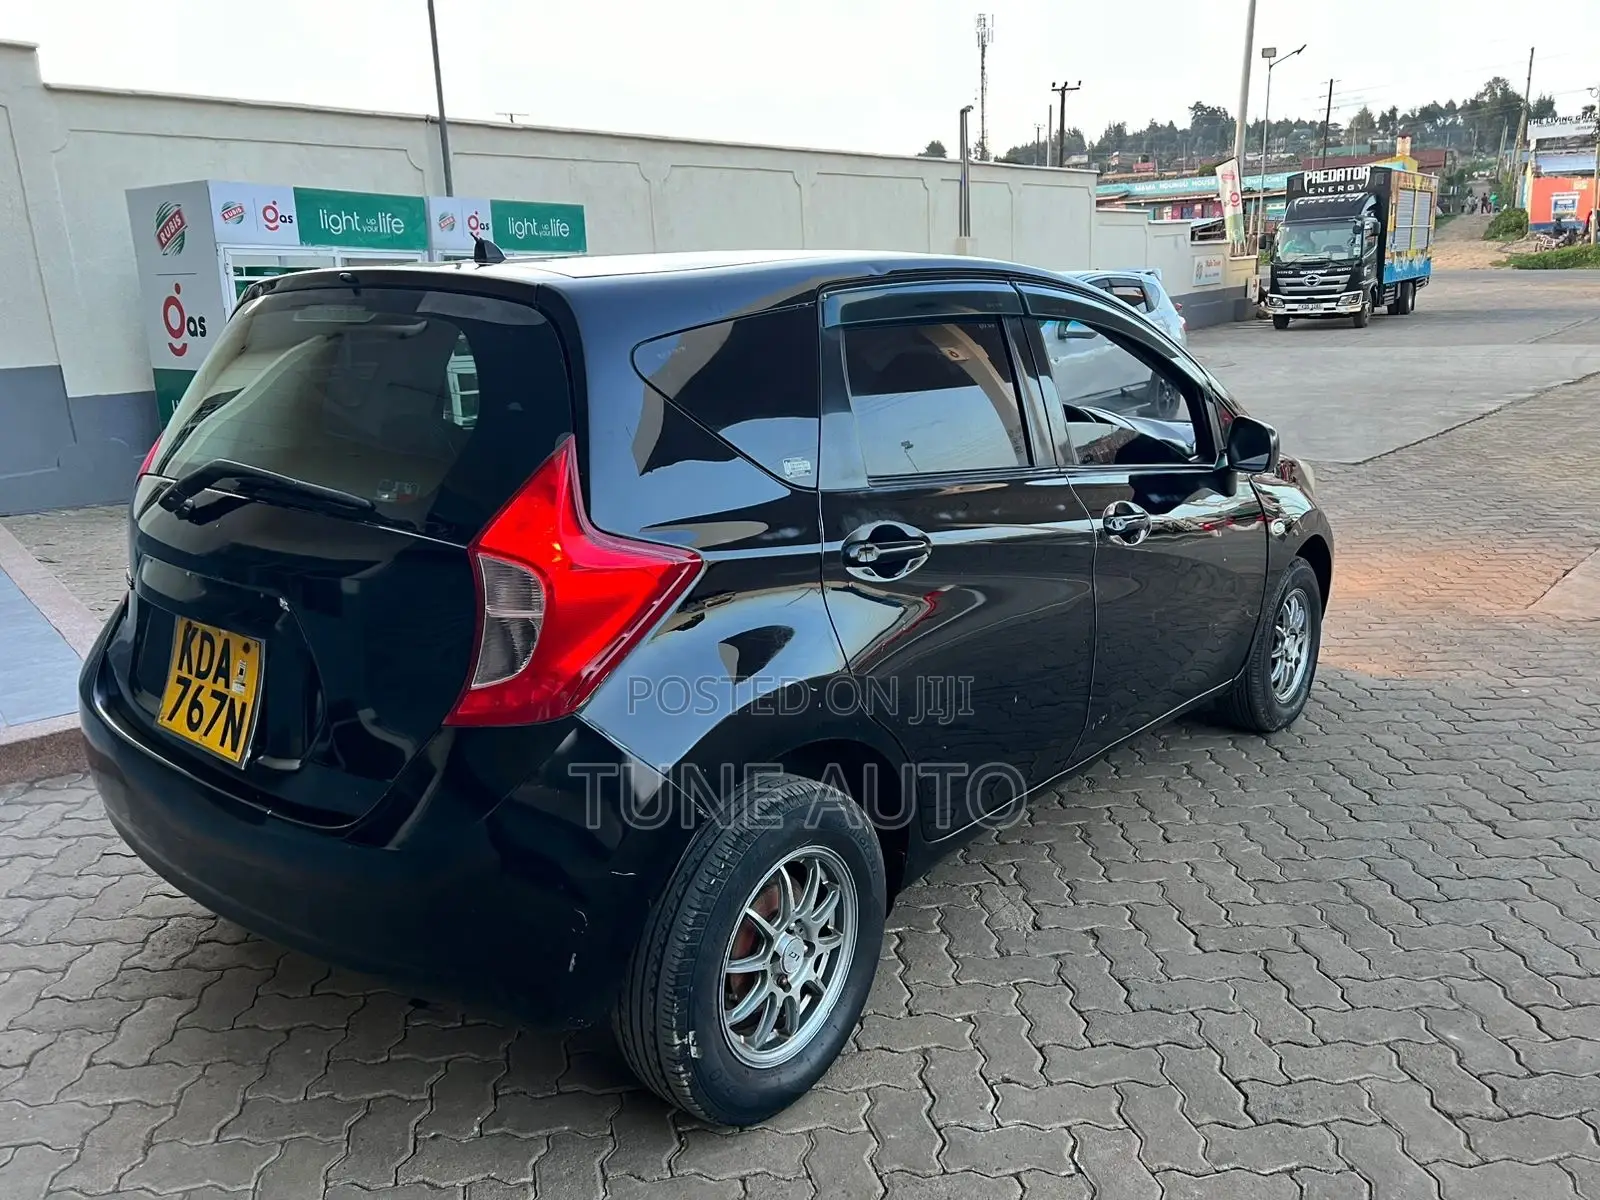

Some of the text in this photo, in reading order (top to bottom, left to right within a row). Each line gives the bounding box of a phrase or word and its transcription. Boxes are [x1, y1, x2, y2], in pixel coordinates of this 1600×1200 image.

[1546, 115, 1573, 124] LIVING
[1575, 112, 1599, 121] GRAC
[1303, 166, 1371, 193] PREDATOR
[1308, 183, 1365, 195] ENERGY
[222, 207, 243, 220] RUBIS
[262, 200, 294, 231] gas
[319, 208, 405, 235] light up your life
[159, 213, 182, 244] RUBIS
[508, 216, 539, 239] light
[550, 218, 570, 238] life
[163, 282, 207, 357] gas
[177, 622, 231, 690] KDA
[167, 674, 247, 753] 767N
